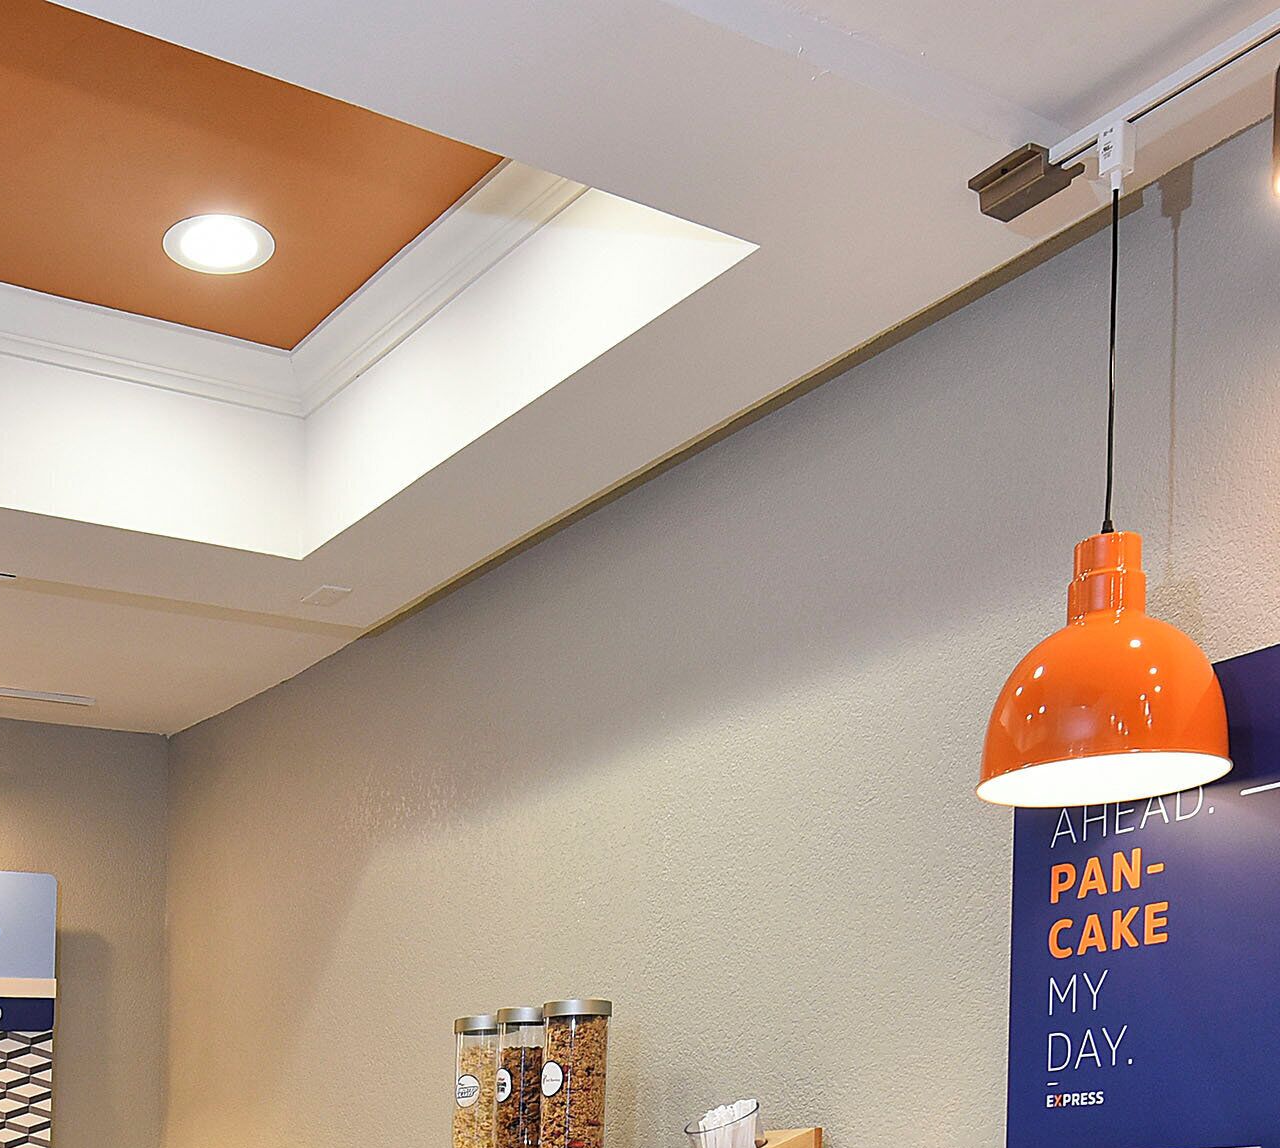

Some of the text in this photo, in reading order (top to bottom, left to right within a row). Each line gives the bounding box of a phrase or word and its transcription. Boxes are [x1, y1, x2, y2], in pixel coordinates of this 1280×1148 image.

[1050, 786, 1215, 848] AHEAD.
[1050, 847, 1165, 904] PAN-
[1048, 901, 1169, 959] CAKE
[1048, 969, 1109, 1016] MY
[1047, 1024, 1134, 1072] DAY.
[1046, 1090, 1105, 1108] EXPRESS
